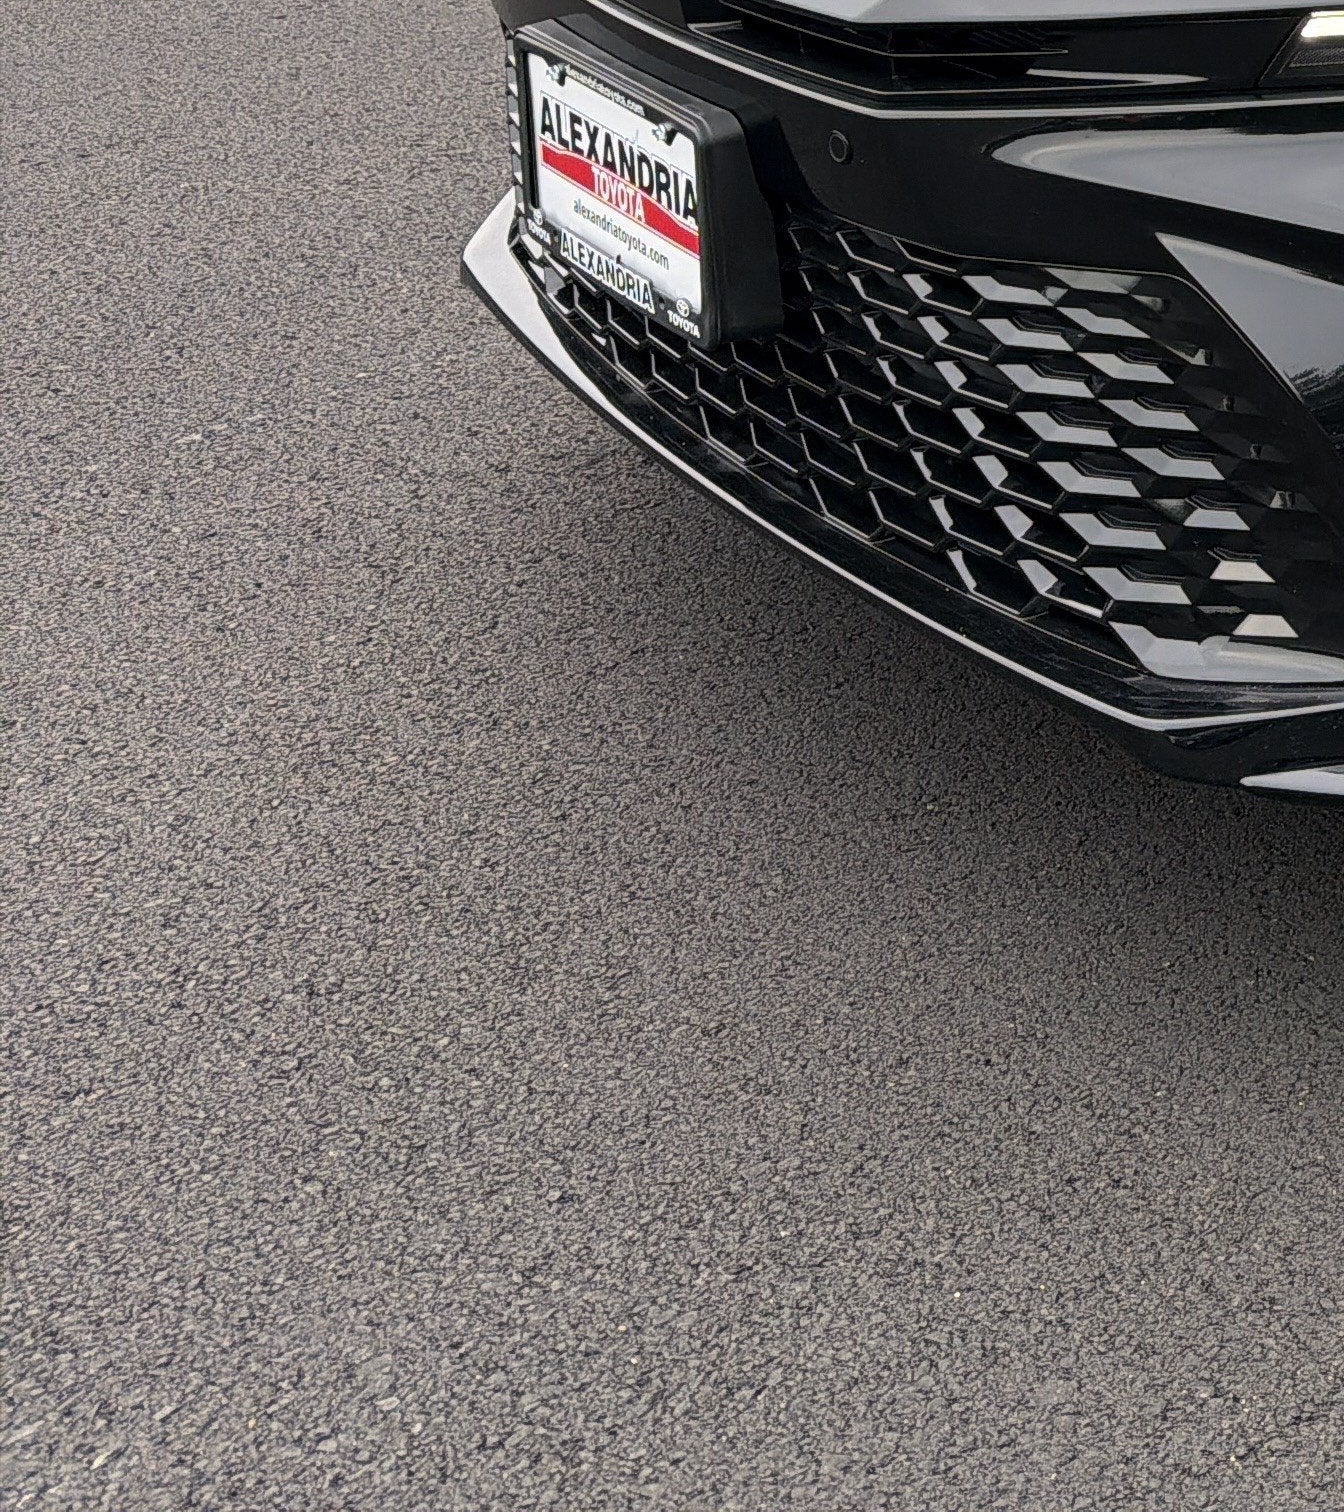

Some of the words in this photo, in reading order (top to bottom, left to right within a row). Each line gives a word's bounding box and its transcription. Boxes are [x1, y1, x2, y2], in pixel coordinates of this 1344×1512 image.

[541, 95, 699, 223] ALEXANDRIA
[591, 164, 646, 223] TOYOTA
[573, 199, 670, 271] alexandriatoyota.com
[561, 230, 655, 314] ALEXANDRIA
[667, 309, 700, 339] TOYOTA
